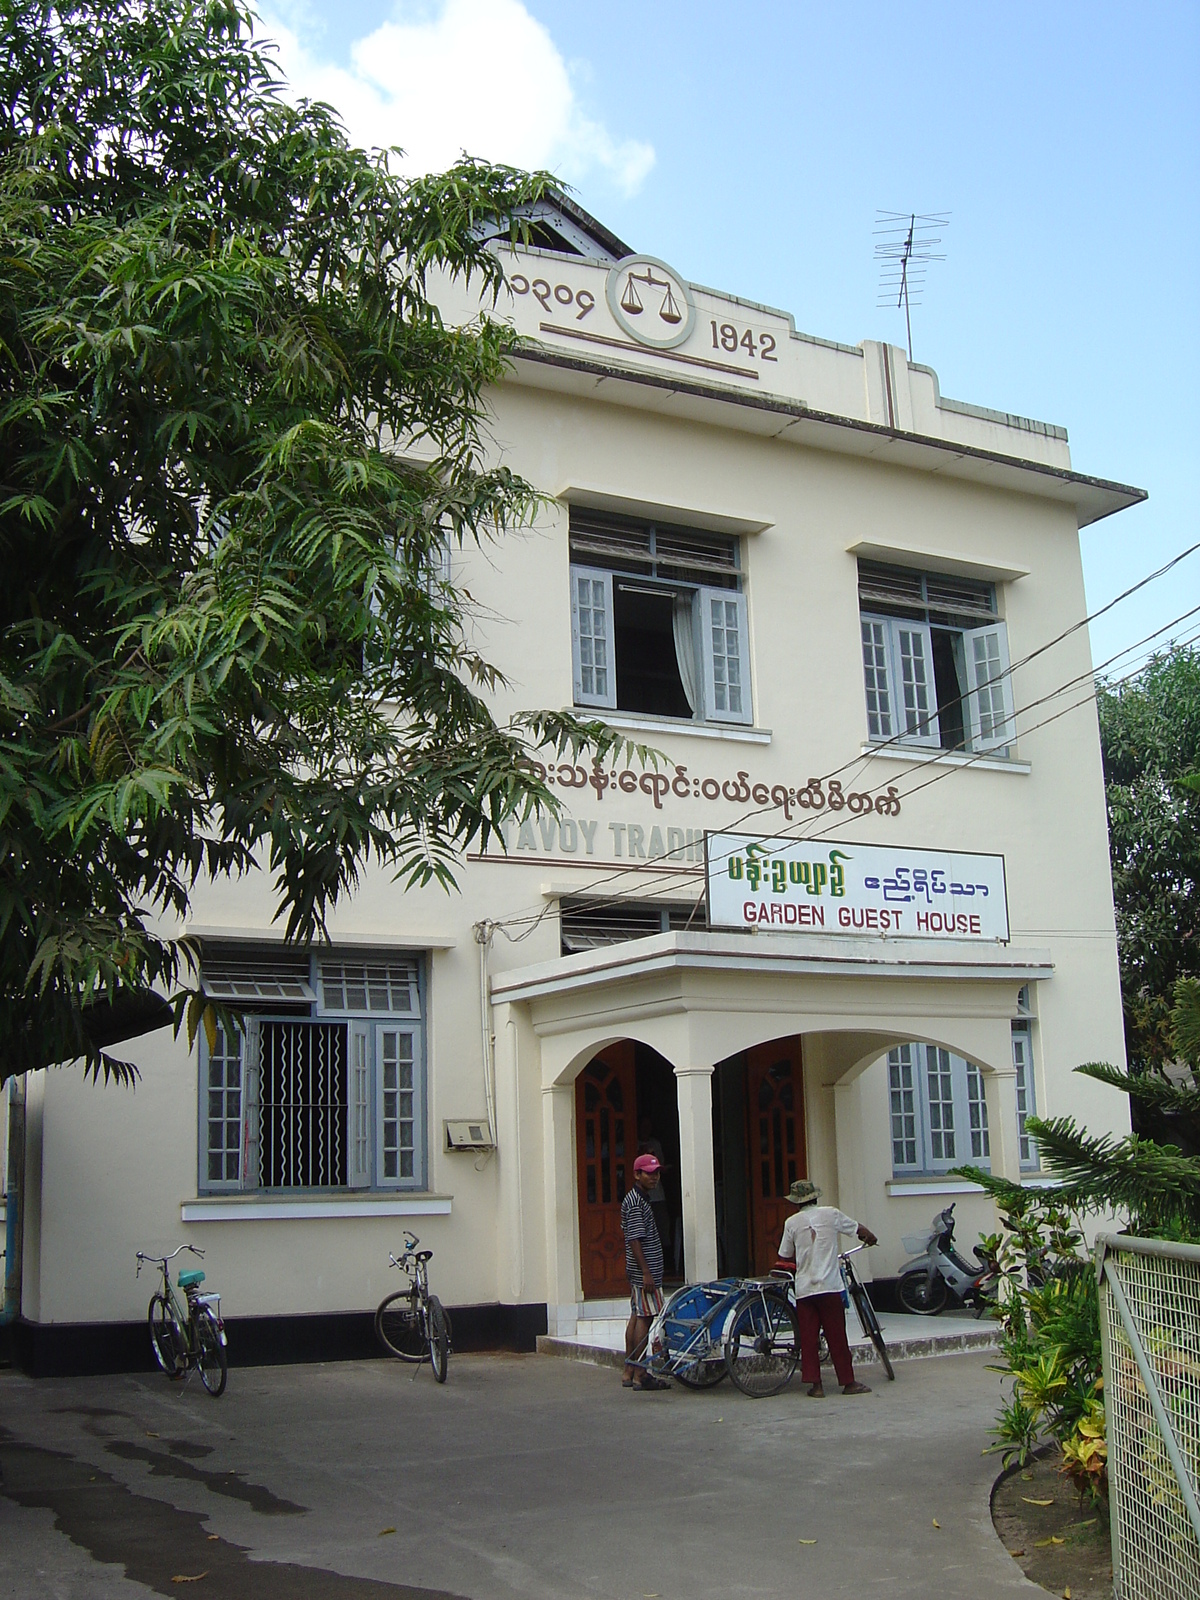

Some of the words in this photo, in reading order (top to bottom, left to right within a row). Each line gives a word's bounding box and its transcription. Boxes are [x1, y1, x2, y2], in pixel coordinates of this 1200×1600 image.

[710, 320, 778, 362] 1942
[501, 813, 598, 854] TAVOY
[743, 901, 825, 926] GARDEN
[838, 907, 903, 930] GUEST
[917, 911, 981, 934] HOUSE
